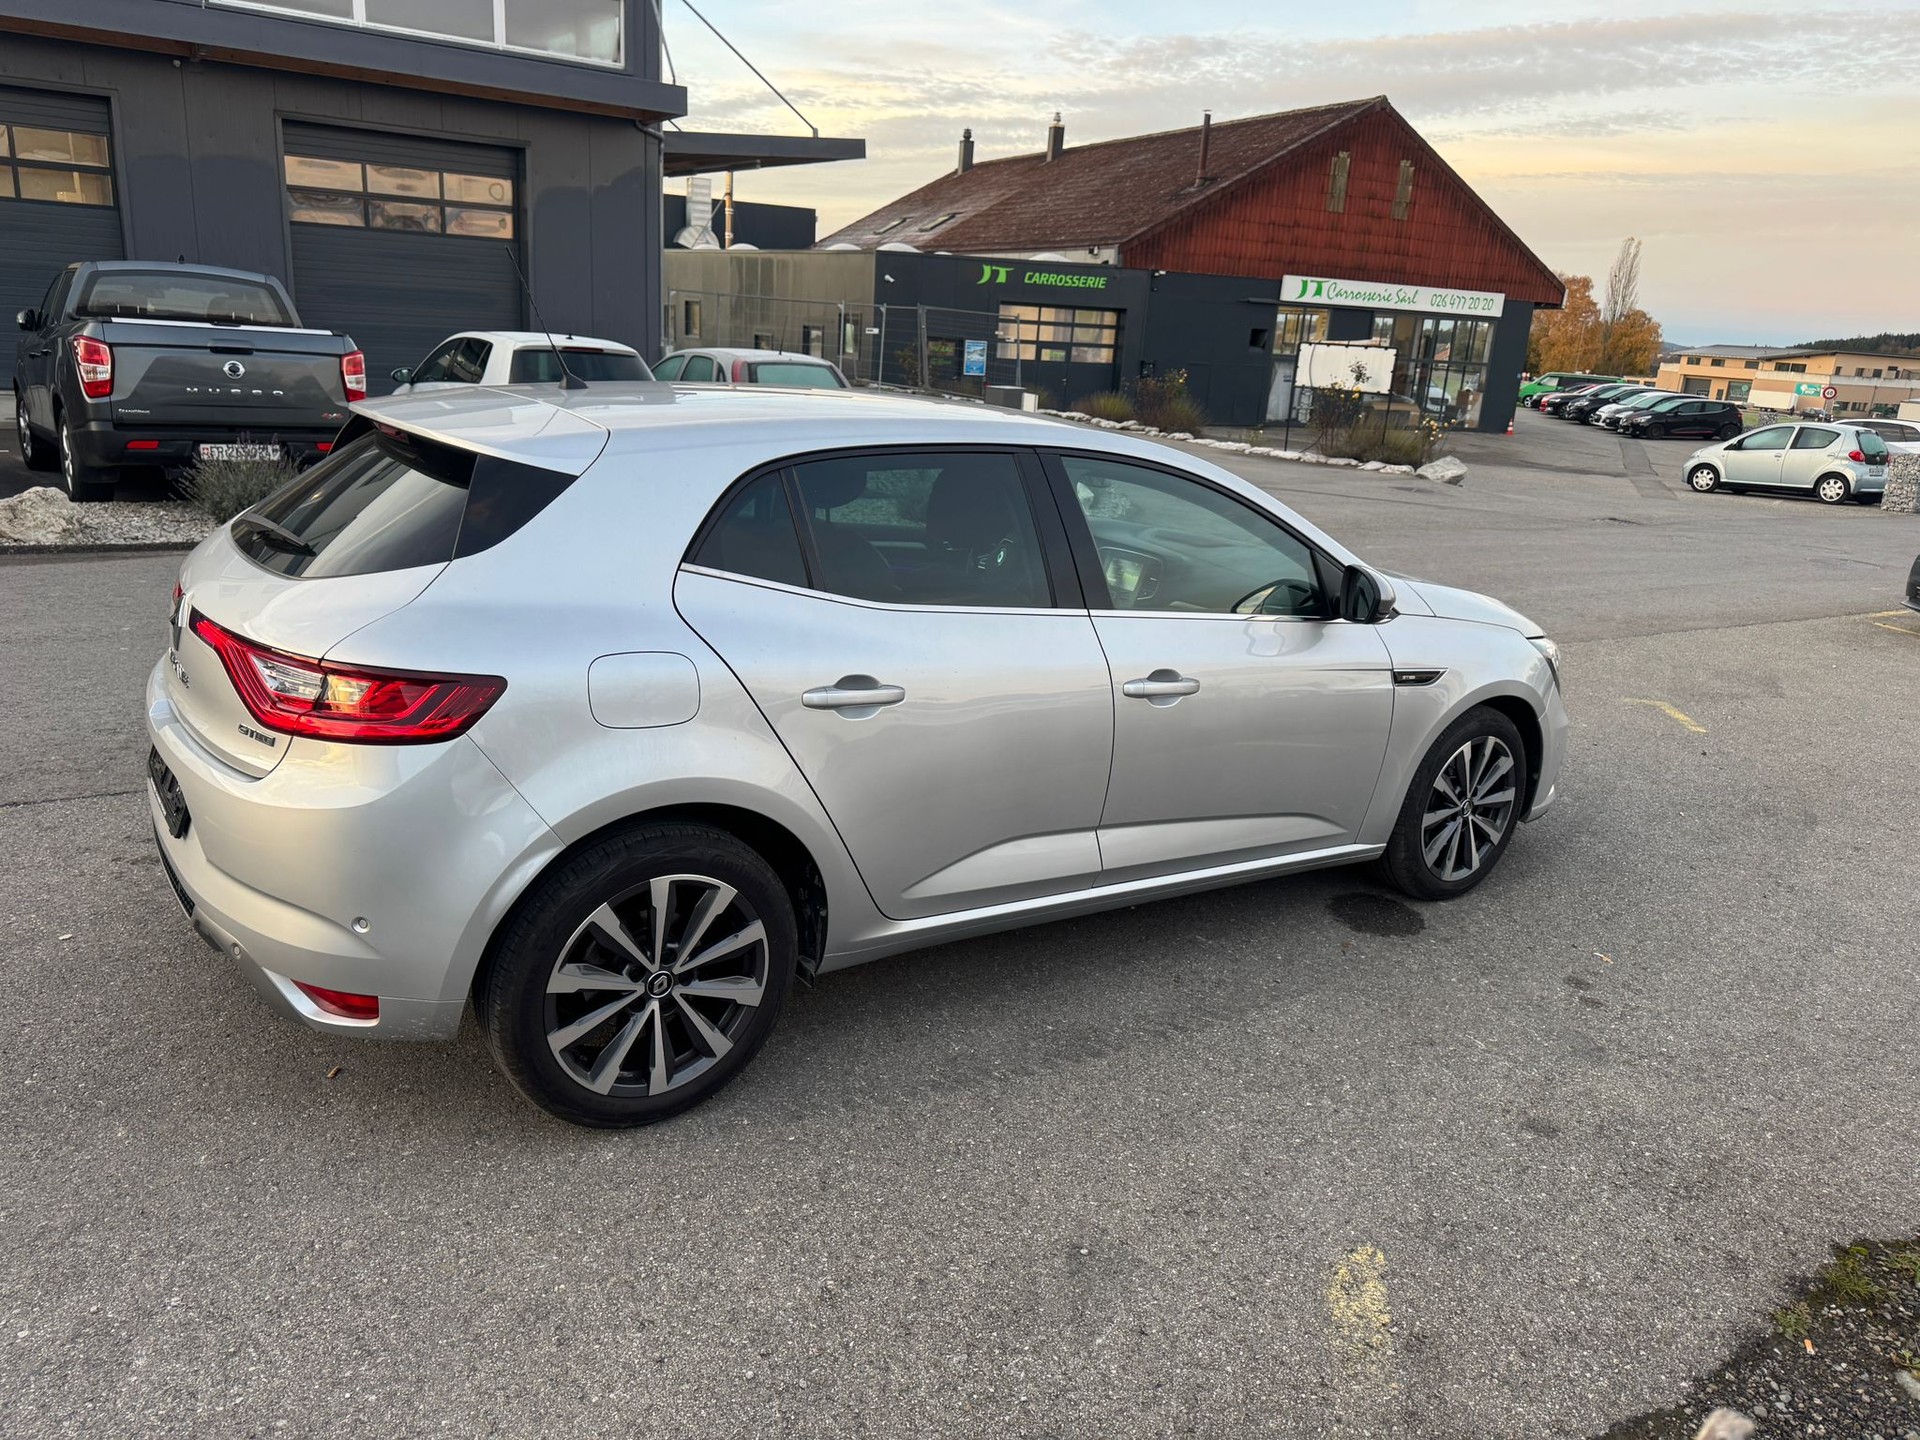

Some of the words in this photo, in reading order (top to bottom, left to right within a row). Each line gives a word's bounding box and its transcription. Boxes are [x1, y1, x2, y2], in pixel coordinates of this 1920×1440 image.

[976, 264, 1014, 285] JT
[1023, 271, 1107, 289] CARROSSERIE
[1296, 279, 1331, 300] JT
[1326, 281, 1393, 303] Carrosserie
[1430, 293, 1448, 308] 026
[1450, 294, 1467, 310] 477
[1468, 296, 1480, 310] 20
[1482, 297, 1494, 311] 20
